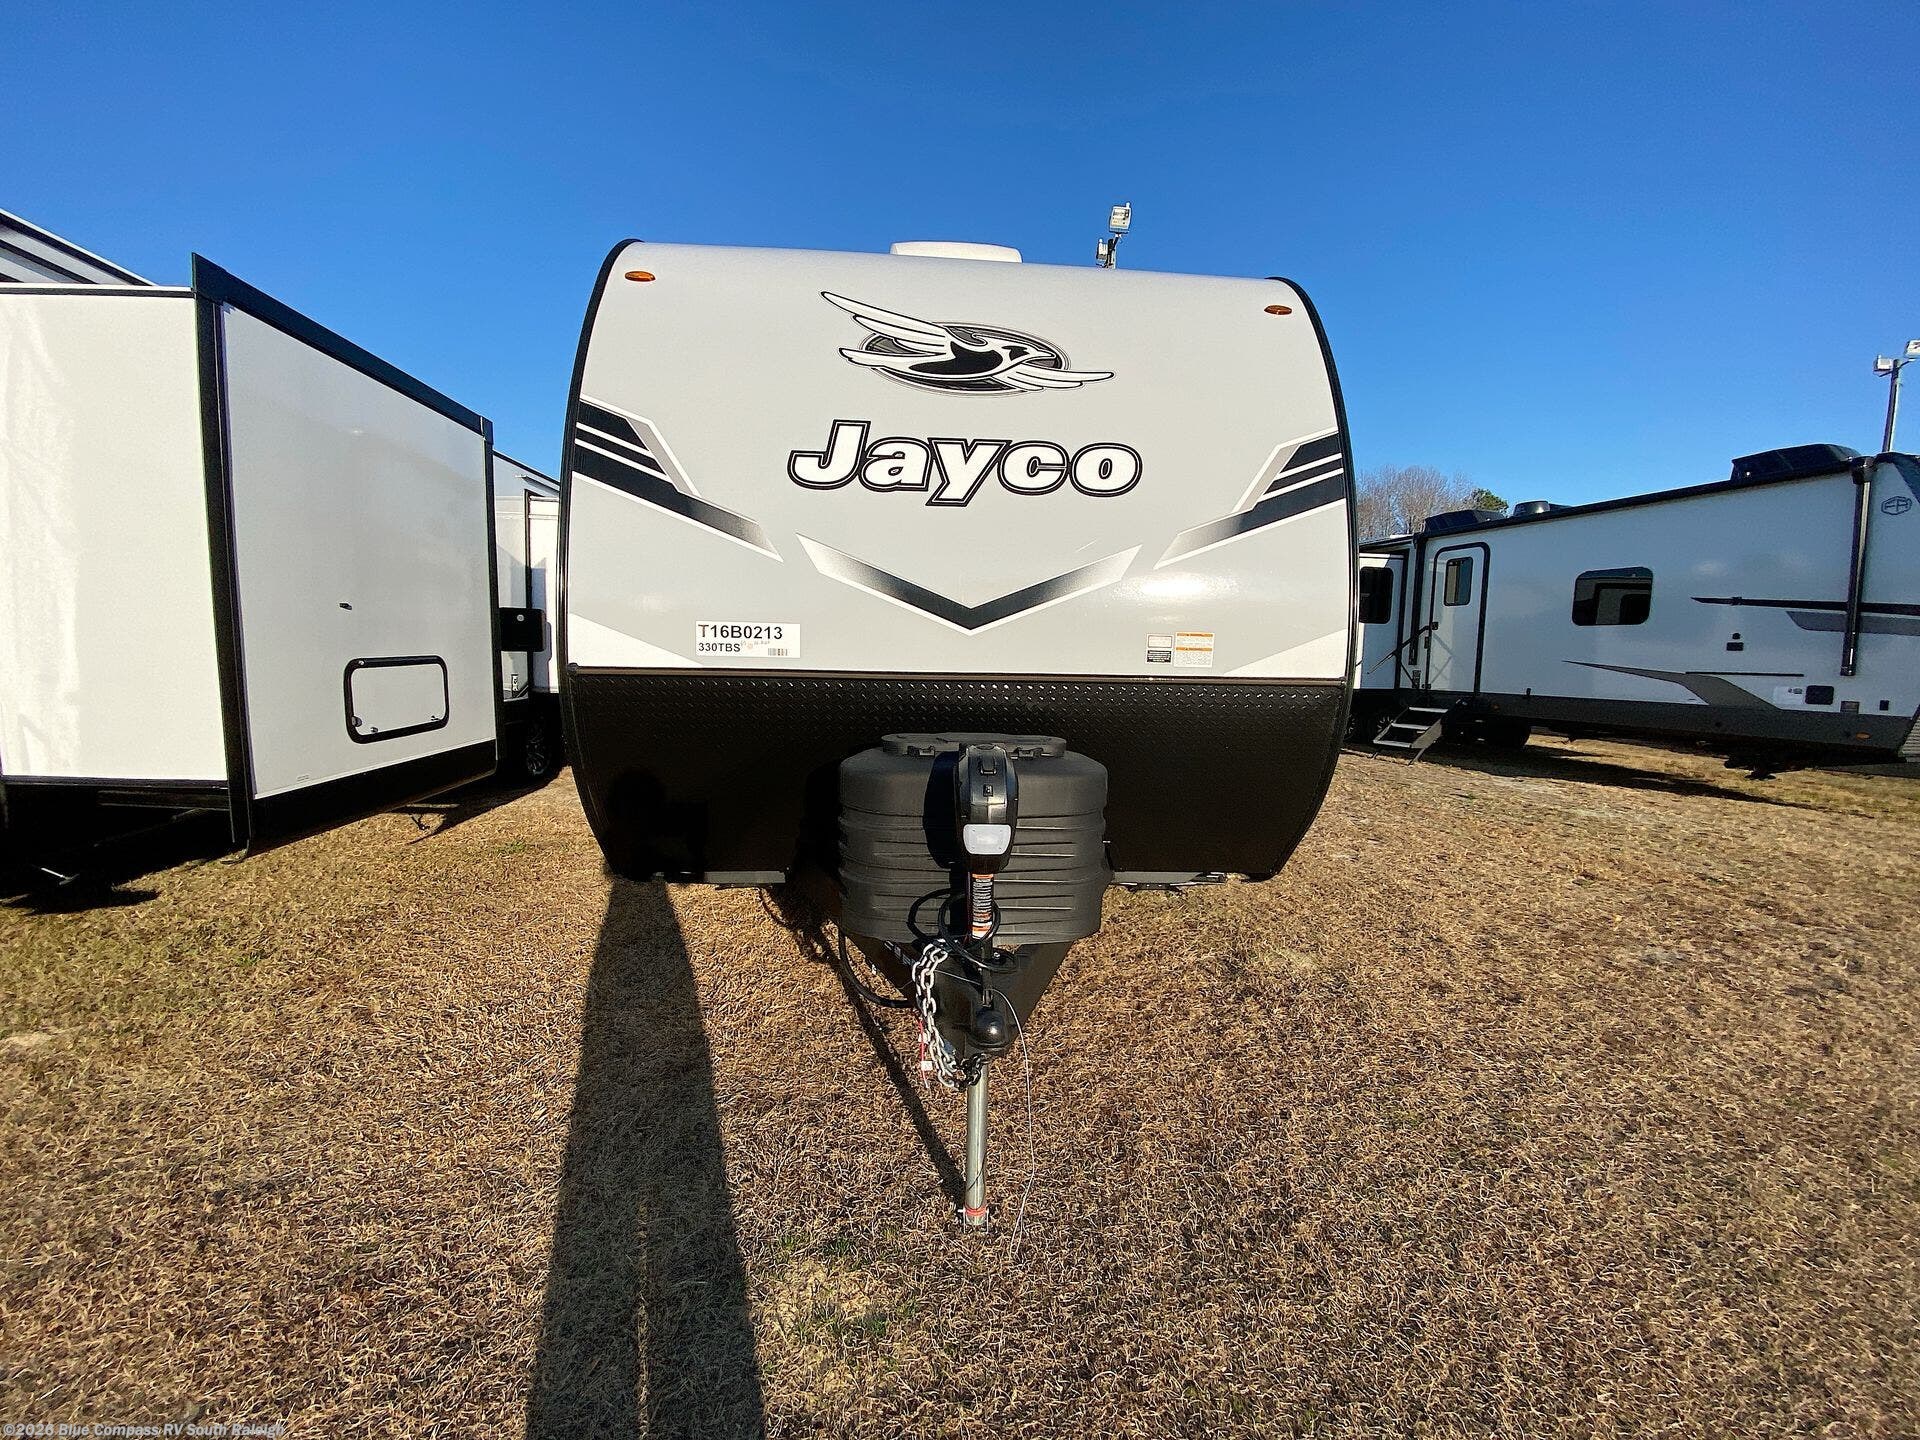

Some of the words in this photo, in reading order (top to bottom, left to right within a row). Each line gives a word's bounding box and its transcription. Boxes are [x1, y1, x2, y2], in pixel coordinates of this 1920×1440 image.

[787, 419, 1143, 507] Jayco
[698, 623, 783, 640] T16B0213
[698, 642, 741, 652] 330TBS
